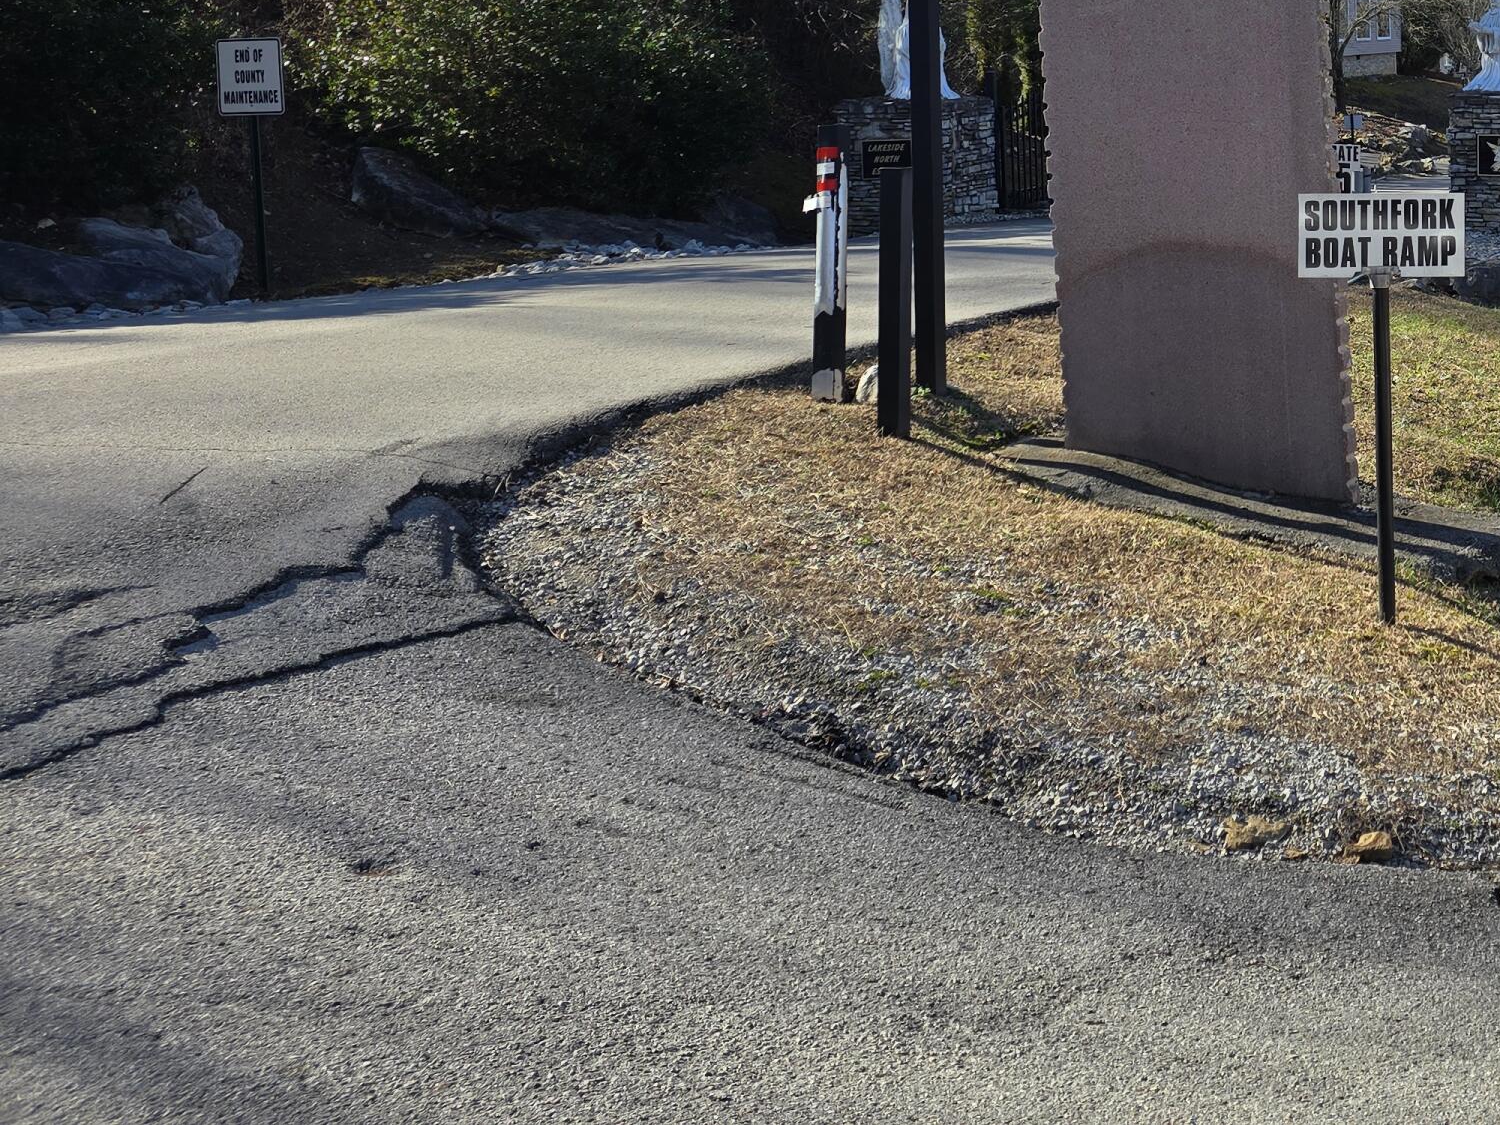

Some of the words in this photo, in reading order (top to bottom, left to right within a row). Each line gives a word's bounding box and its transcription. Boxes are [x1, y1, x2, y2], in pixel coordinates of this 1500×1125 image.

[234, 49, 250, 63] END
[253, 49, 263, 63] OF
[234, 70, 265, 84] COUNTY
[223, 90, 279, 105] MAINTENANCE
[867, 143, 905, 153] LAKESIDE
[873, 155, 901, 163] NORTH
[1304, 198, 1456, 231] SOUTHFORK
[1305, 237, 1371, 268] BOAT
[1382, 235, 1457, 267] RAMP
